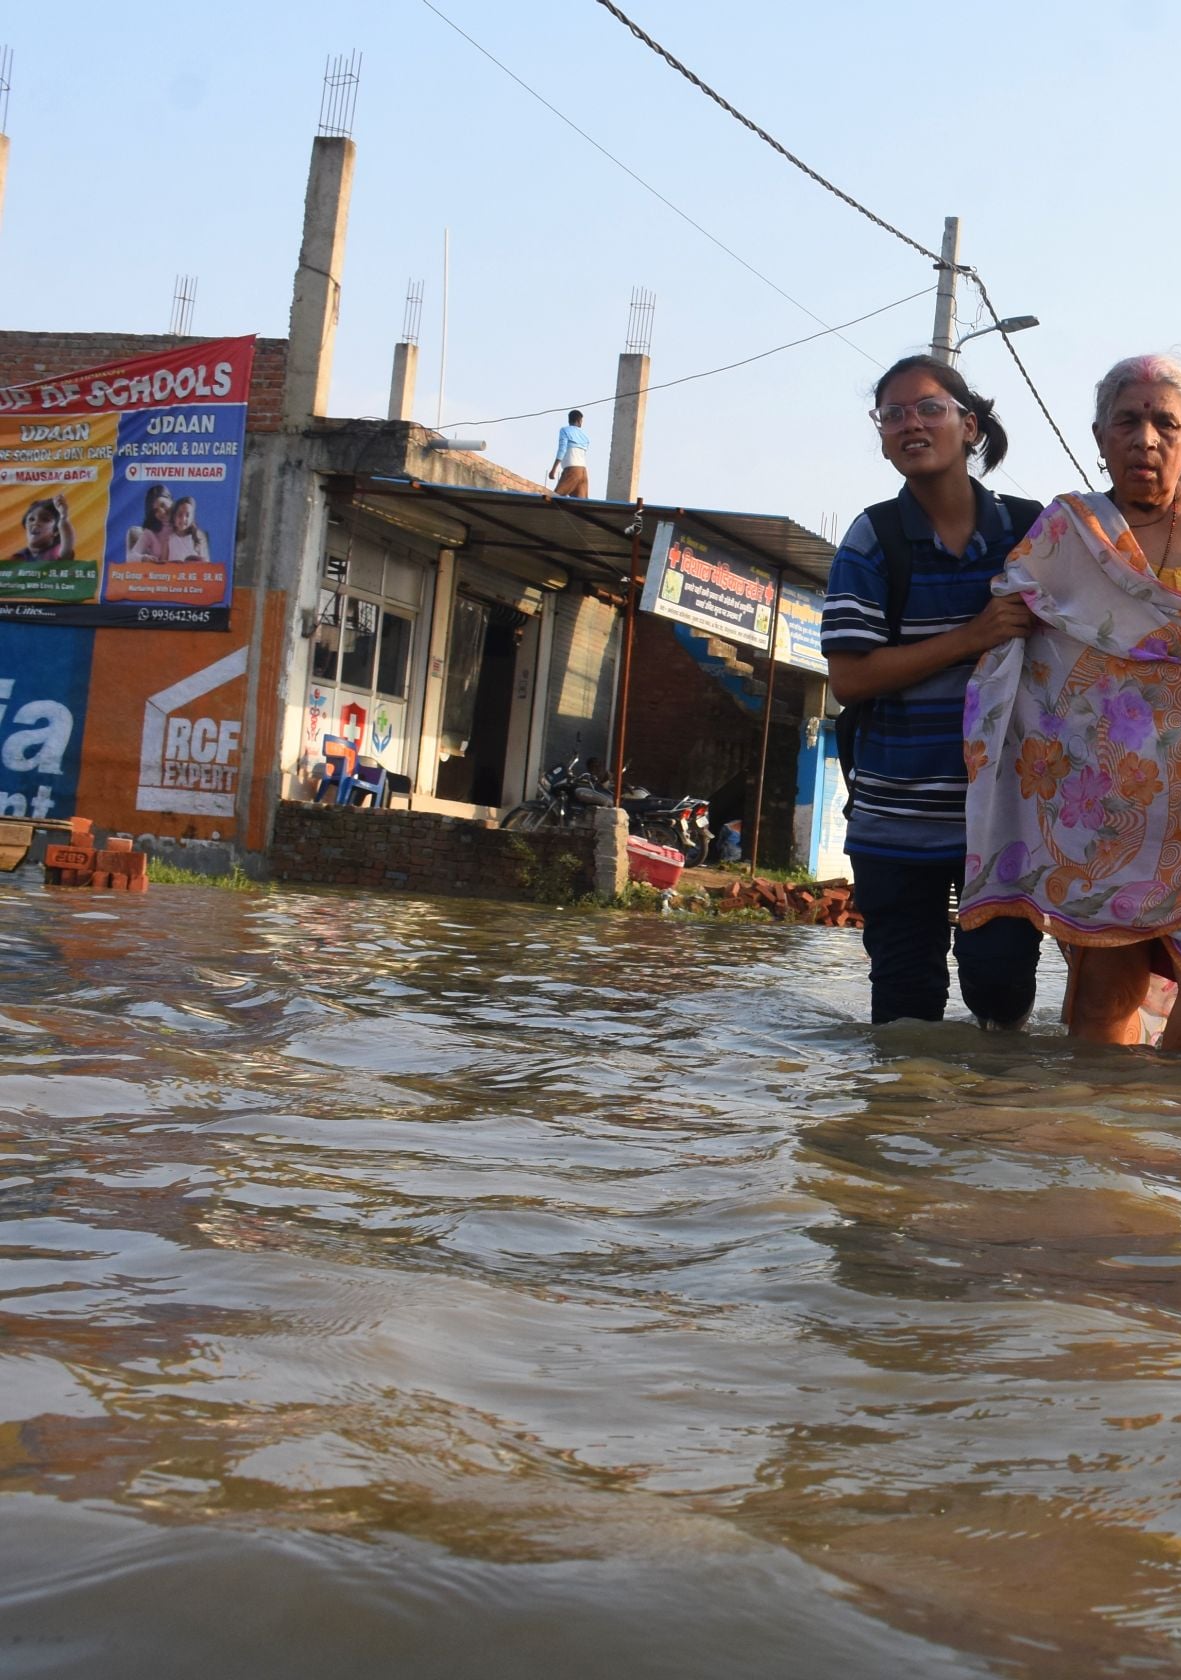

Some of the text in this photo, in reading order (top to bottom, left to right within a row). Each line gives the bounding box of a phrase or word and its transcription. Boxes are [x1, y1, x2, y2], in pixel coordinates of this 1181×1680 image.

[85, 361, 233, 407] SCHOOLS
[20, 423, 90, 442] UDAAN
[147, 414, 216, 435] UDAAN
[118, 442, 238, 457] PRE SCHOOL & DAY CARE
[145, 466, 224, 478] TRIVENI NAGAR
[151, 608, 210, 623] 9936423645
[165, 717, 241, 765] RCF
[163, 760, 239, 792] EXPERT
